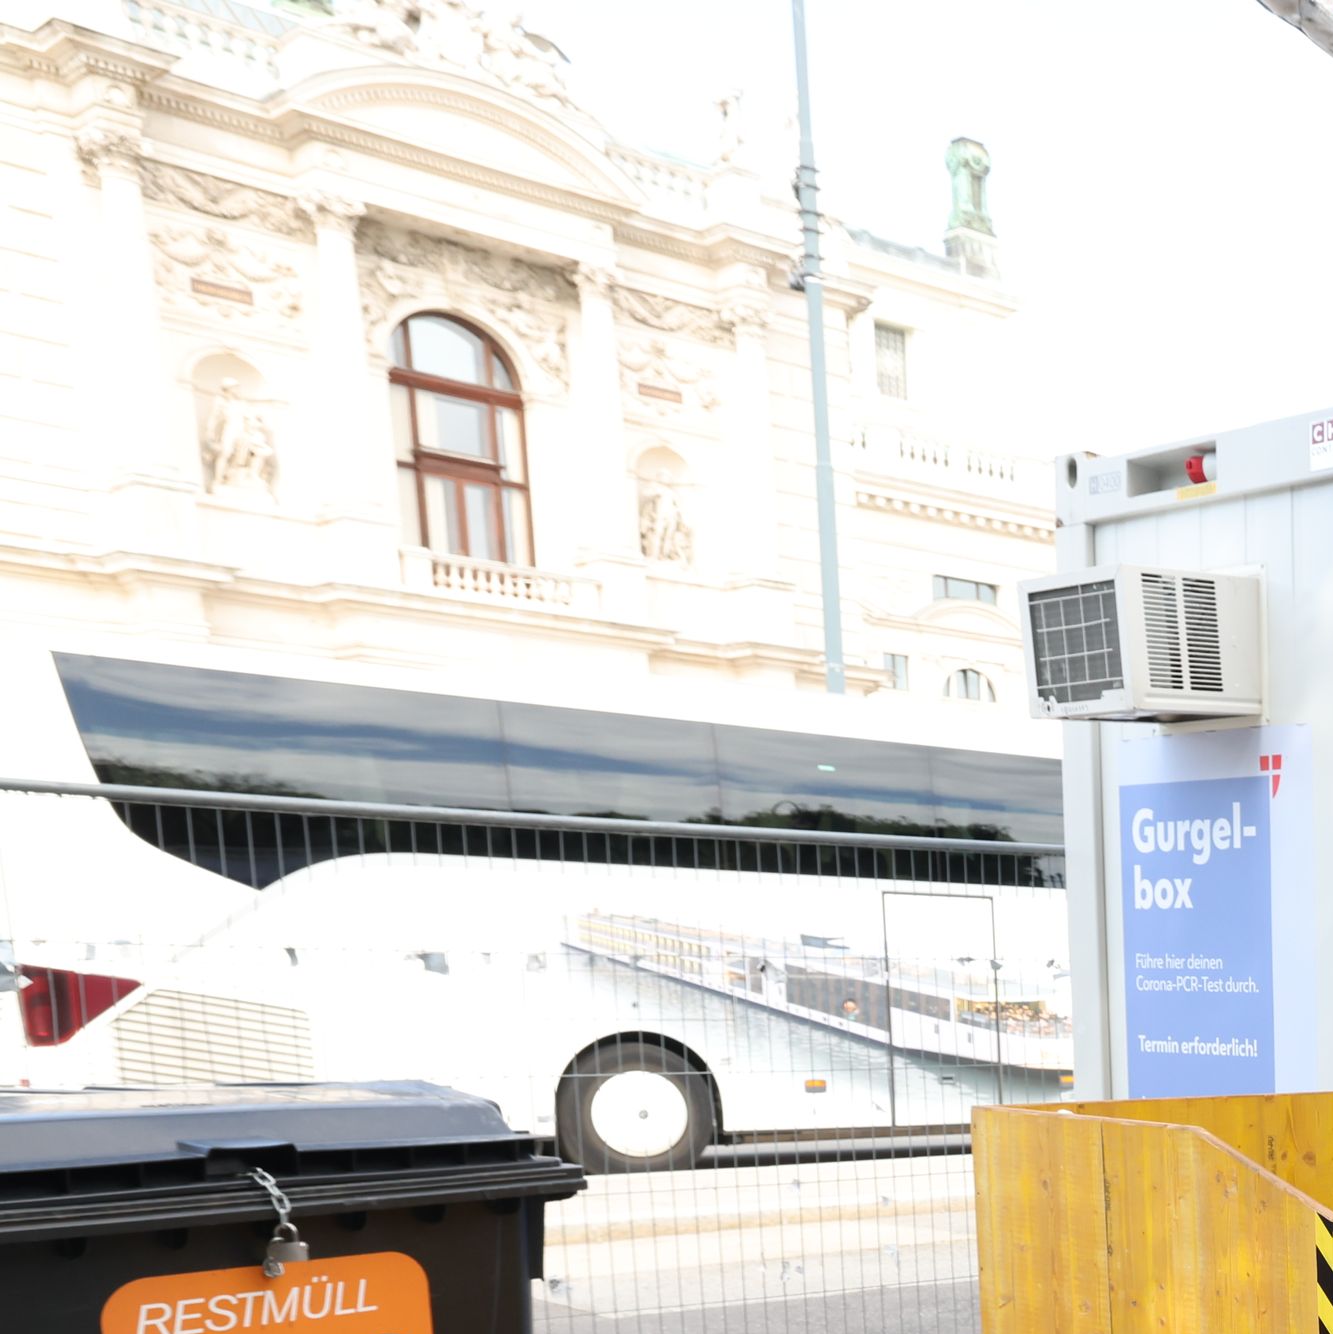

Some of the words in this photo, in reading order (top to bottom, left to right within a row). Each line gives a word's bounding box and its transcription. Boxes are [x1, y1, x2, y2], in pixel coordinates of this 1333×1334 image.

[1132, 801, 1257, 865] Gurgel-
[1134, 864, 1194, 910] box
[1135, 952, 1165, 969] Führe
[1165, 953, 1185, 970] hier
[1187, 954, 1223, 970] deinen
[1136, 975, 1224, 992] Corona-PCR-Test
[1225, 976, 1259, 993] durch.
[1138, 1034, 1179, 1054] Termin
[1181, 1036, 1258, 1058] erforderlich!
